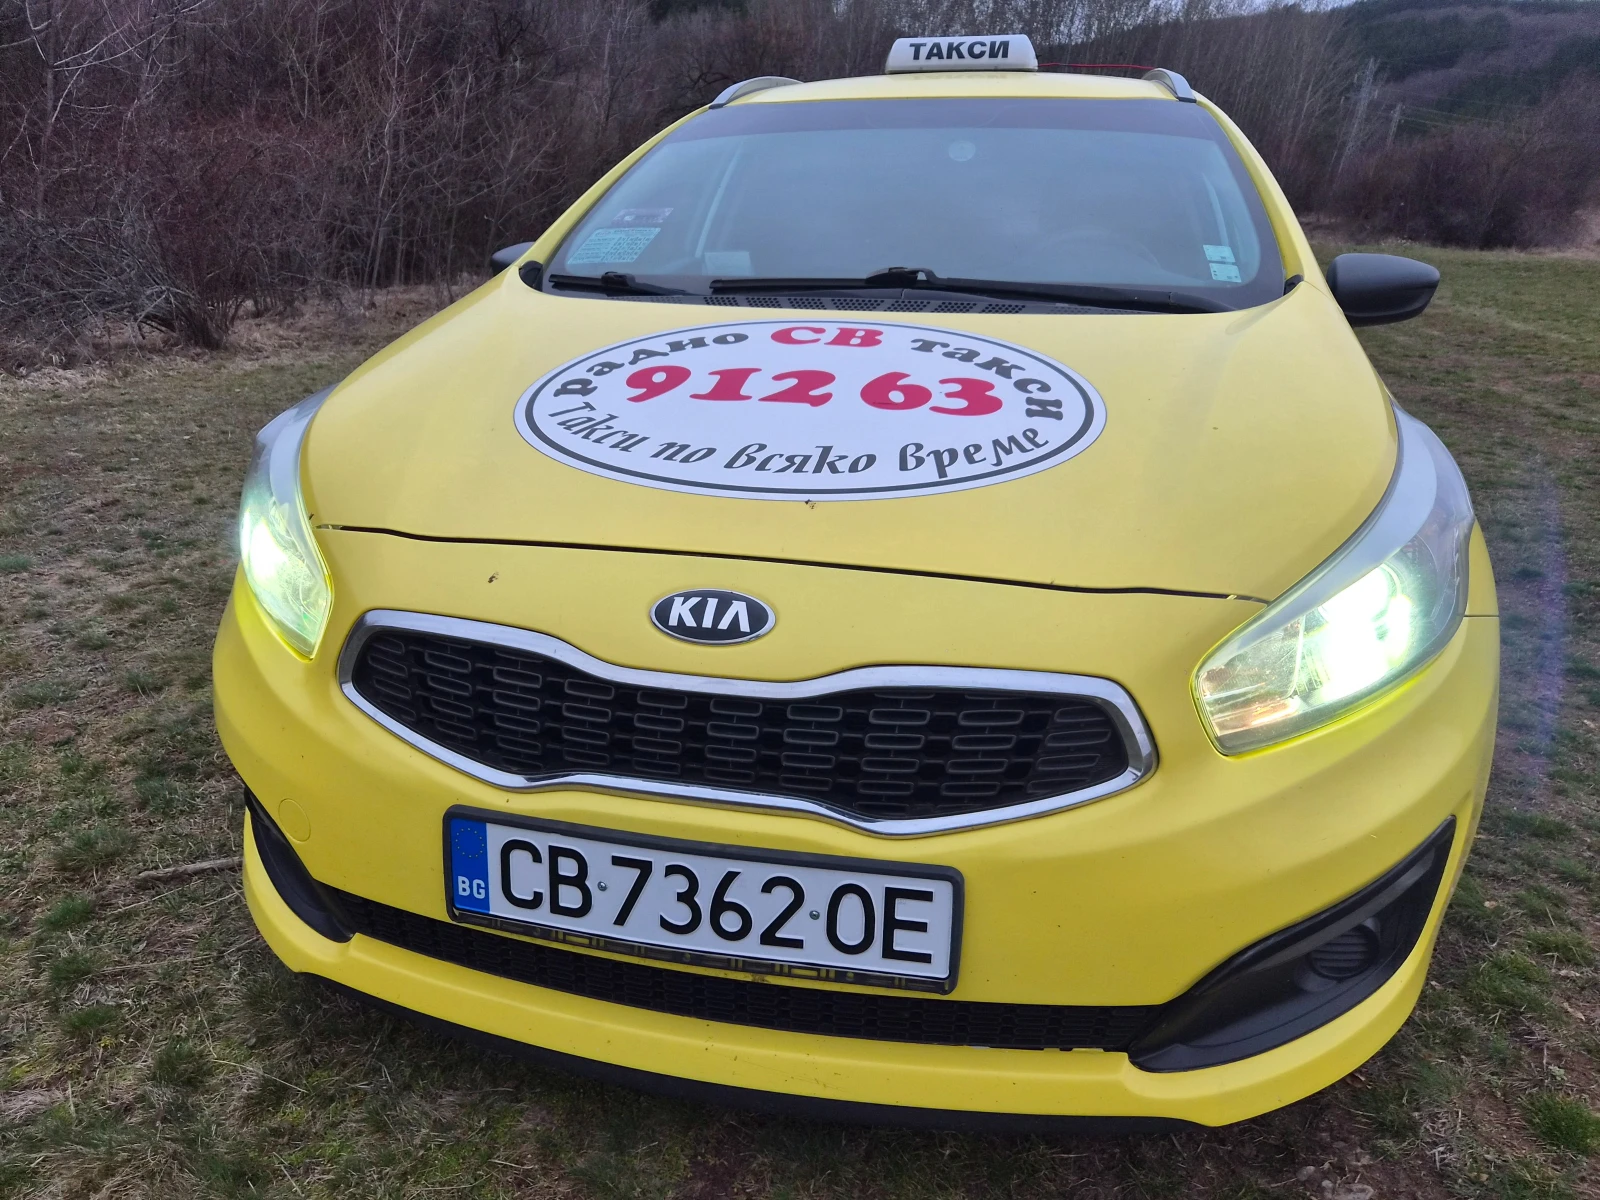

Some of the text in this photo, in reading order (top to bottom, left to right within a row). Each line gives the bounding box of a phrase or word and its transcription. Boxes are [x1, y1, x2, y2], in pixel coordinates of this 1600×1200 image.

[909, 40, 1010, 61] ТАКСИ
[553, 332, 750, 399] радио
[910, 338, 1064, 422] такси
[625, 364, 1004, 417] 912 63
[549, 401, 651, 452] Такси
[650, 438, 717, 464] по
[668, 596, 751, 633] KIA
[457, 875, 486, 899] BG
